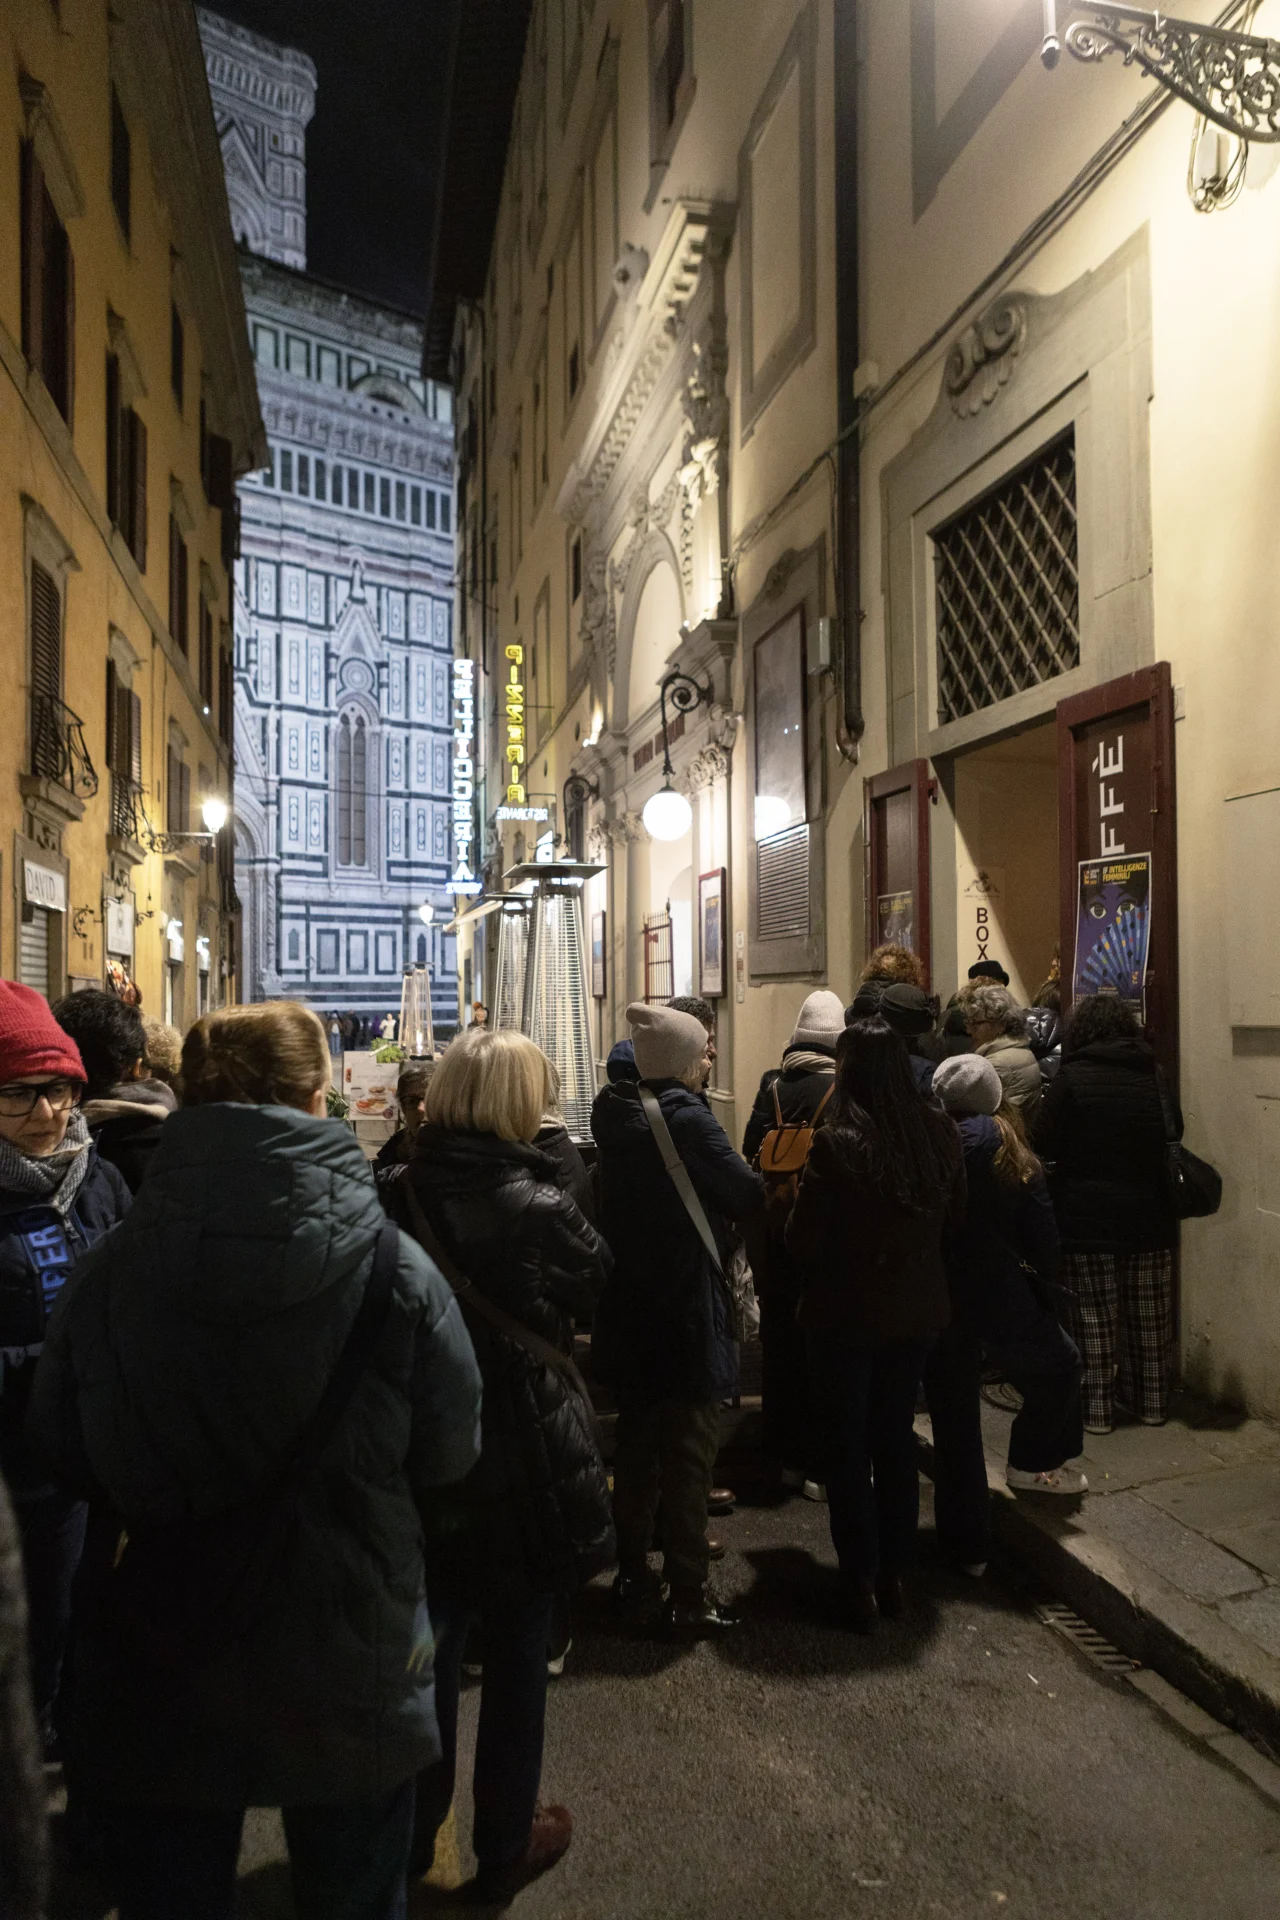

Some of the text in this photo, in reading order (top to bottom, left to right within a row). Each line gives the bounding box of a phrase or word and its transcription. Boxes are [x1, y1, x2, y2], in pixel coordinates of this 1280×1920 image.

[1092, 735, 1125, 857] FFÈ
[26, 867, 56, 902] DAVID
[976, 907, 989, 960] BOX
